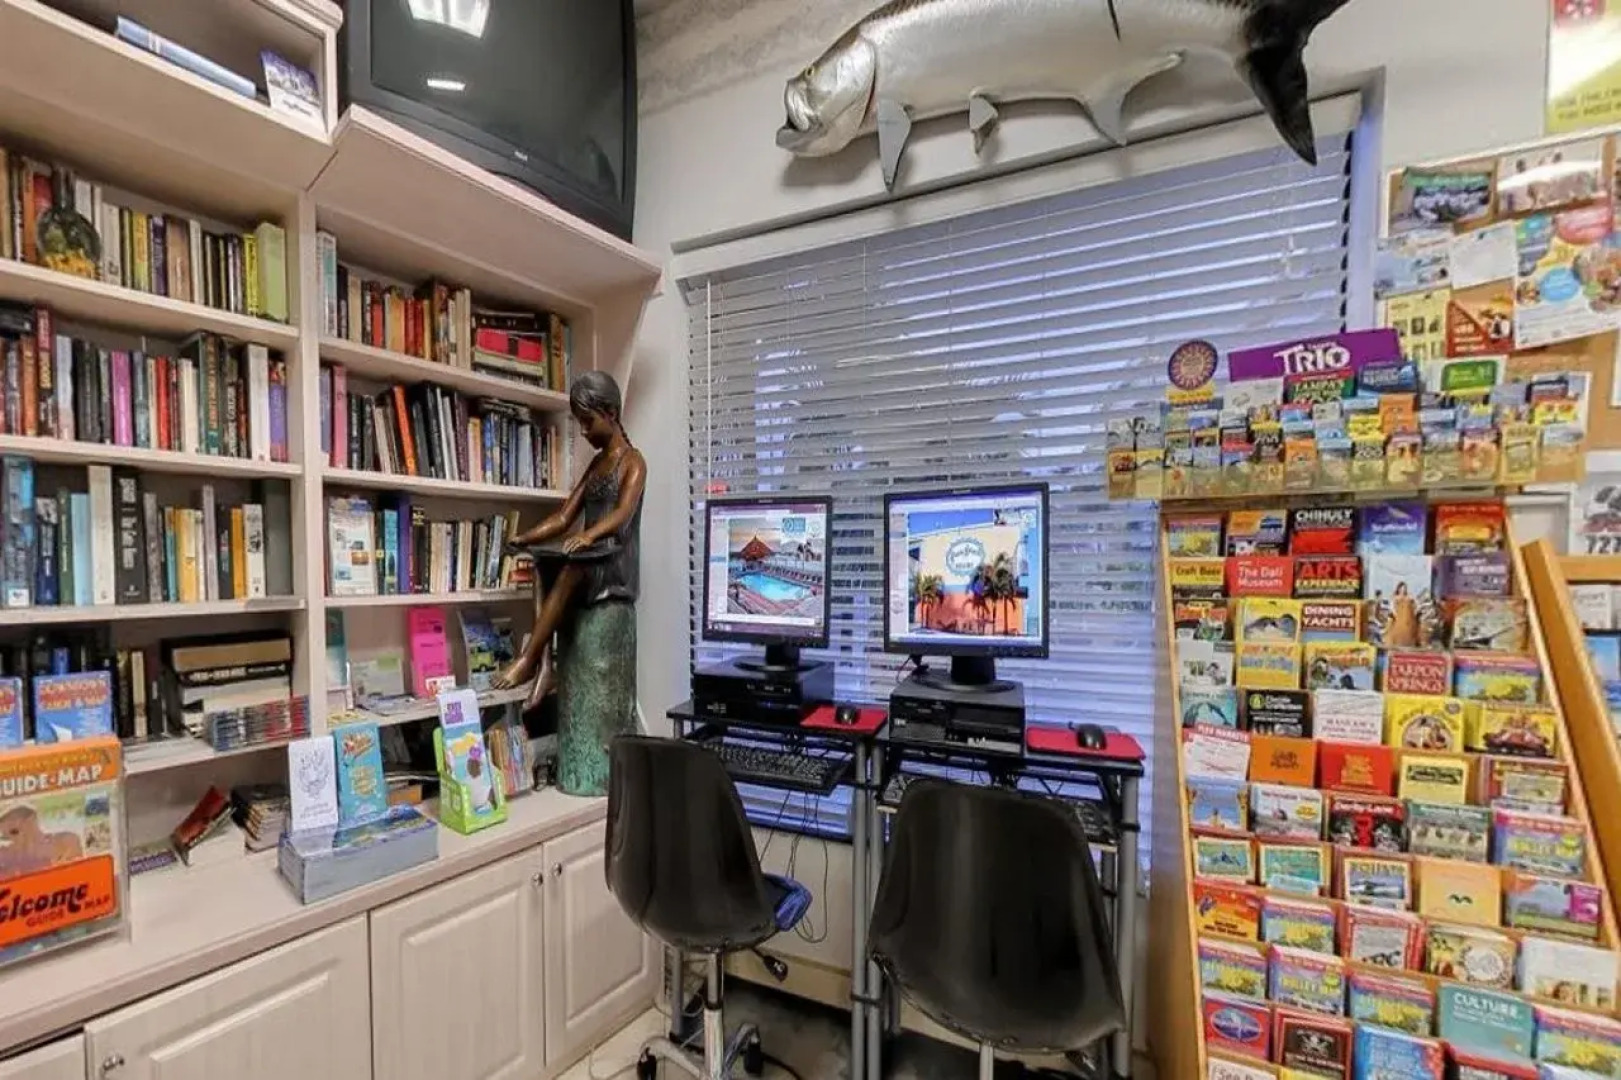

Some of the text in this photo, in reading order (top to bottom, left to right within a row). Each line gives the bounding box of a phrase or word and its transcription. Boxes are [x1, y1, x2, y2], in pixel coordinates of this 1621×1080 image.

[1273, 344, 1350, 376] TRIO
[1296, 508, 1351, 523] CHIHULY
[1237, 565, 1259, 577] The
[1301, 561, 1360, 579] ARTS
[1237, 578, 1284, 588] Museum
[1303, 605, 1354, 617] DINING
[1302, 617, 1354, 629] YACHTS
[1389, 677, 1445, 692] SPRINGS
[0, 883, 89, 924] elcome
[1454, 992, 1520, 1019] CULTURE
